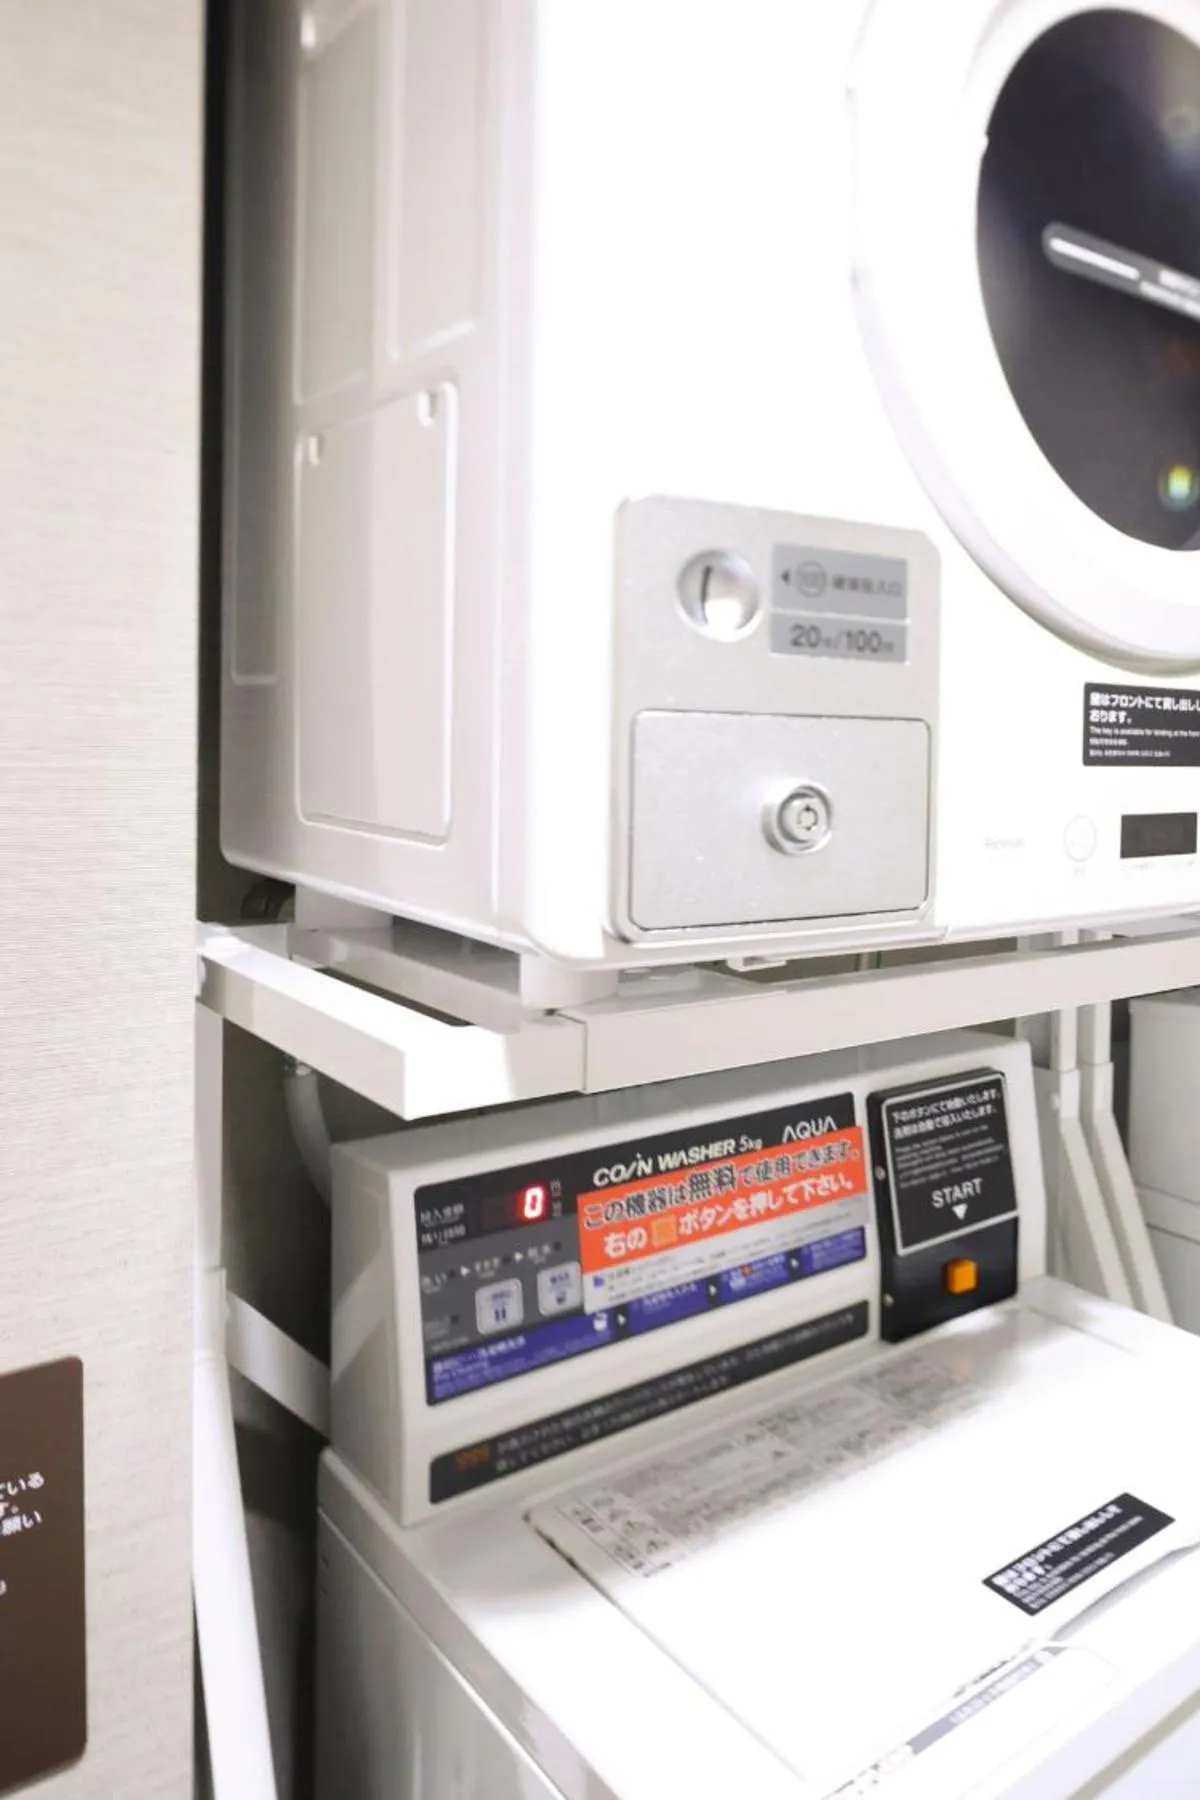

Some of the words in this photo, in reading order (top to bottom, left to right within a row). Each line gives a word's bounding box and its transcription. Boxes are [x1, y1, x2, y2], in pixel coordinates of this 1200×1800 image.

[781, 1115, 839, 1145] AQUA
[657, 1137, 736, 1171] WASHER
[523, 1186, 546, 1220] 0
[931, 1177, 984, 1209] START
